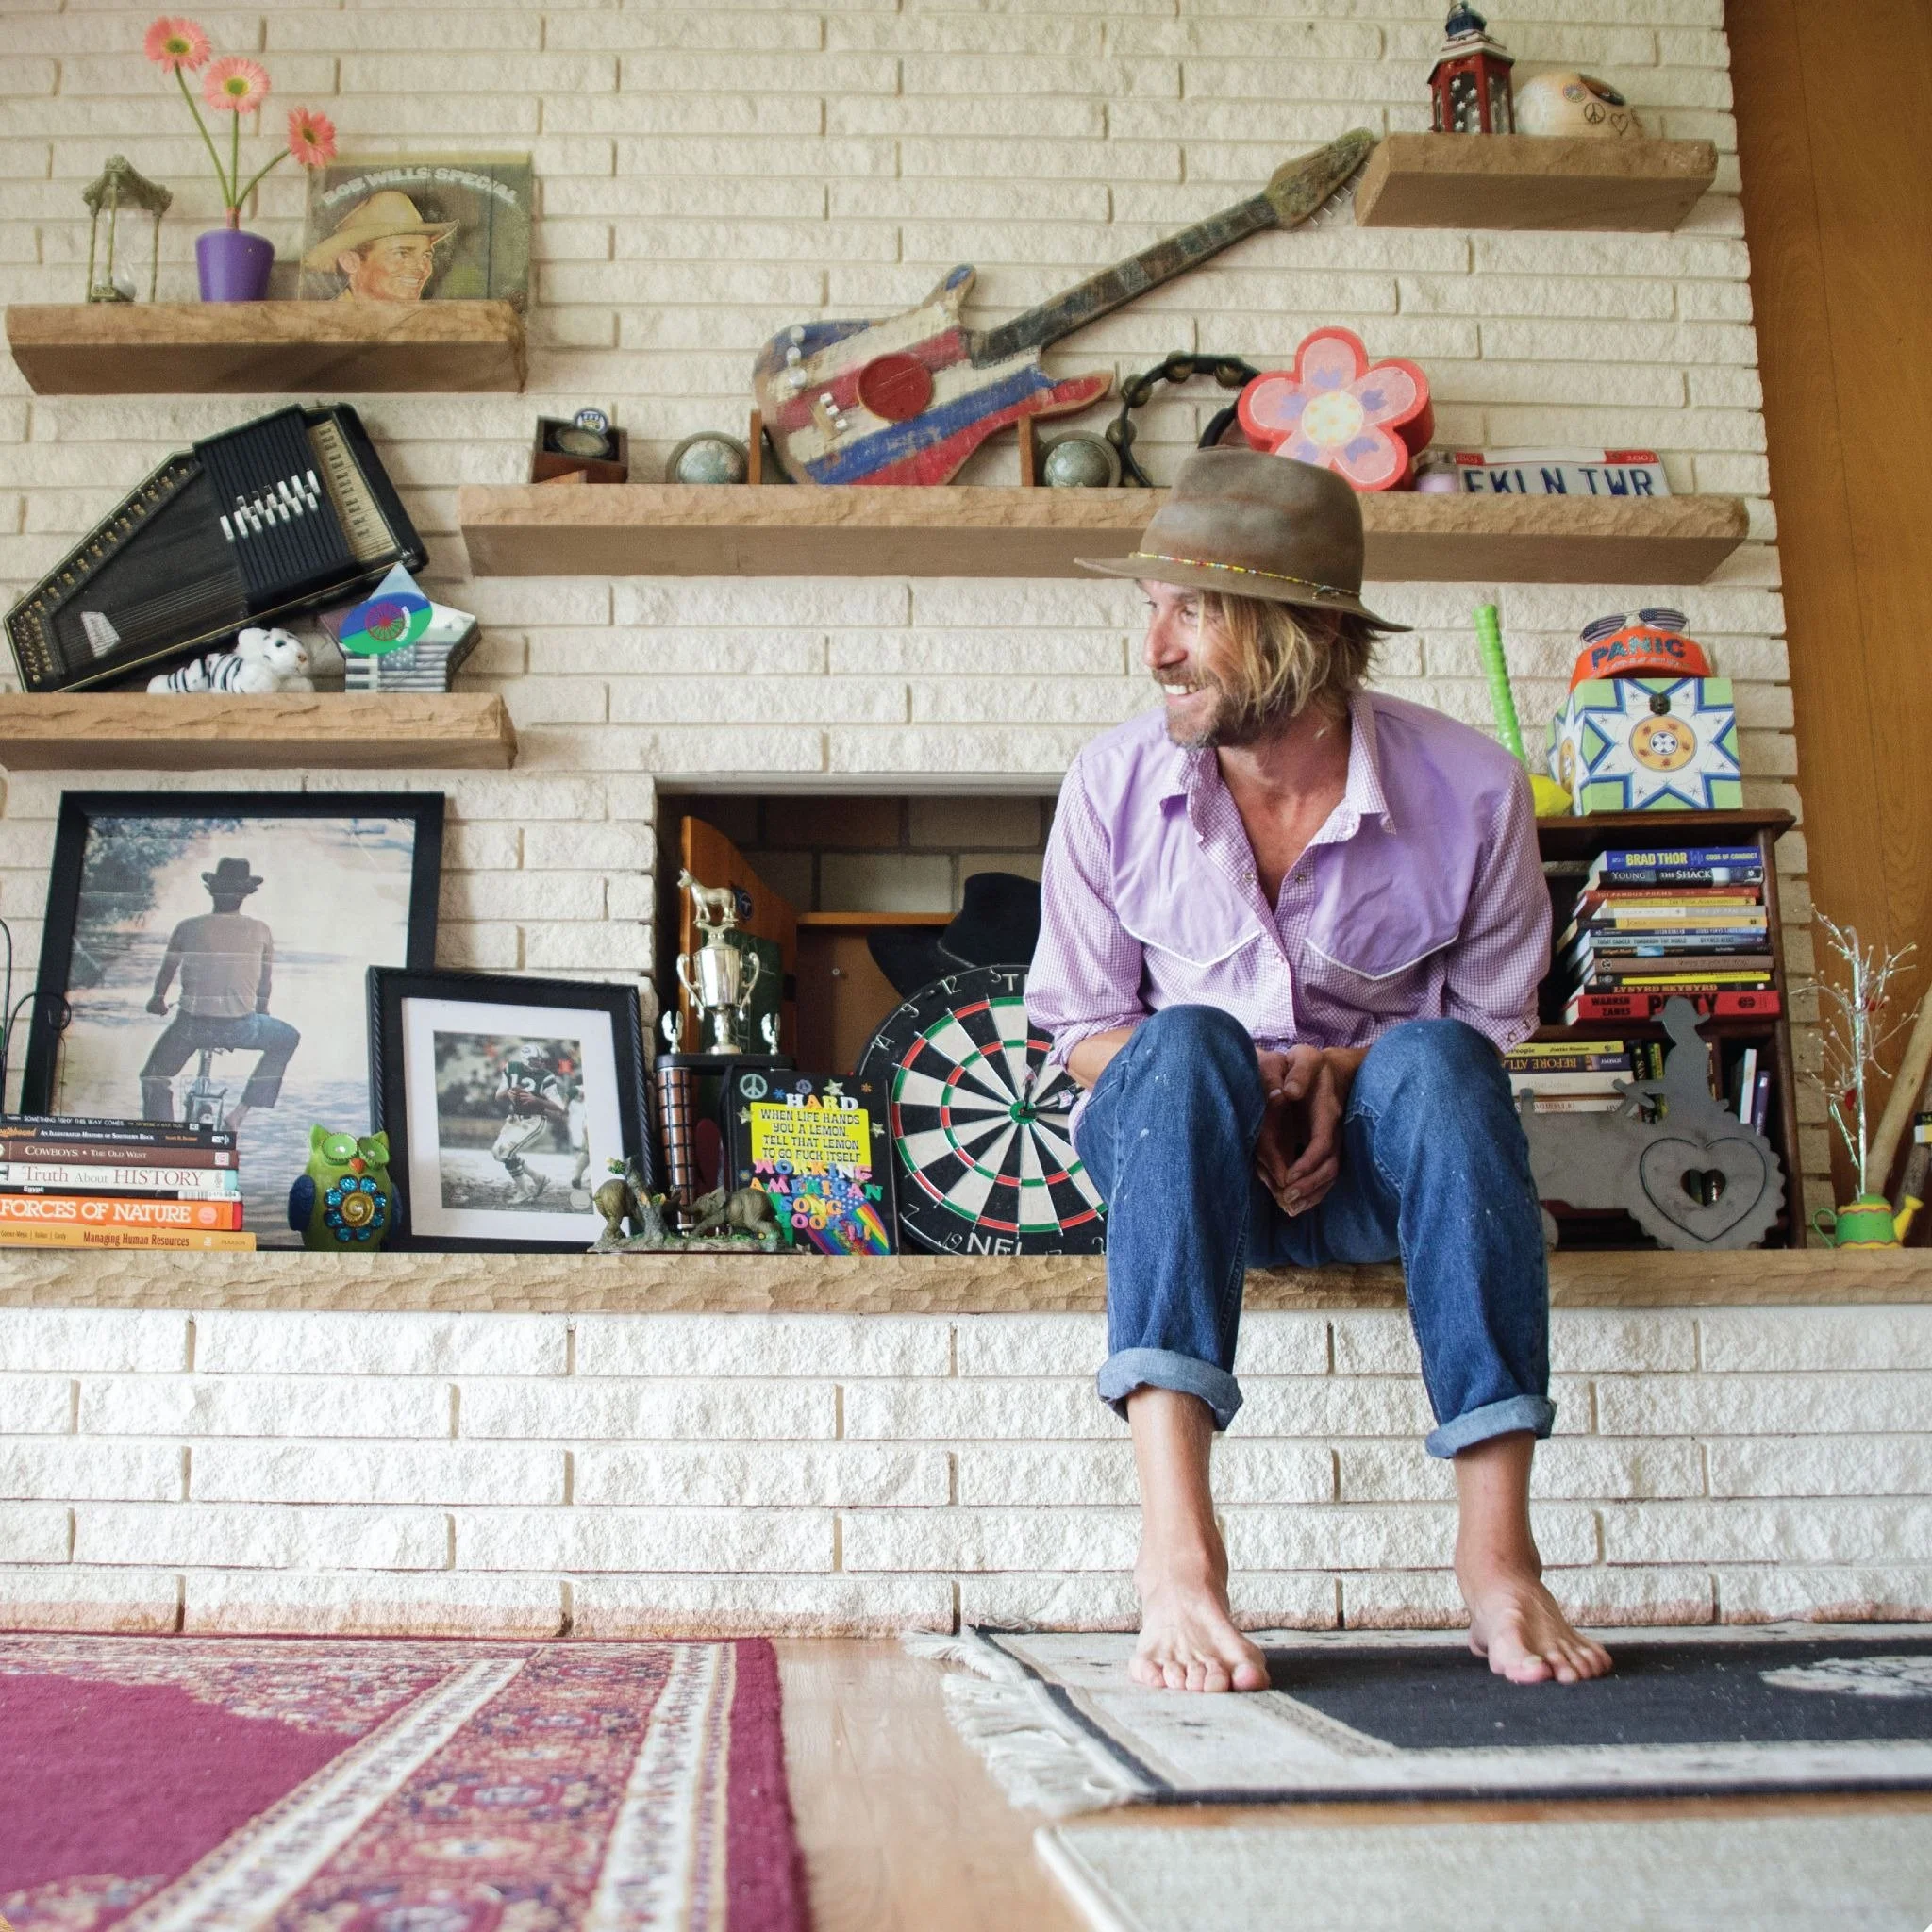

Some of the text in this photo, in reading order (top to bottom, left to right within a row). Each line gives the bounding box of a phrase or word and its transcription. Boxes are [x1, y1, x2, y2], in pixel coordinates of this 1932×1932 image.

[322, 167, 518, 205] BOB WILLS SPECIAL
[1591, 636, 1686, 670] PANIC
[1625, 853, 1656, 866] BRAD
[1657, 852, 1688, 865] THOR
[1731, 852, 1758, 860] CONDUCT
[1612, 872, 1646, 880] YOUNG
[1676, 870, 1712, 879] SHACK
[1532, 1058, 1576, 1070] BEFORE
[786, 1093, 858, 1111] HARD
[24, 1115, 57, 1124] SOMETHING
[761, 1109, 860, 1125] WHEN LIFE HANDS
[773, 1123, 794, 1134] YOU
[798, 1124, 806, 1135] A
[763, 1135, 859, 1150] TELL THAT LEMON
[25, 1145, 78, 1157] COWBOYS
[762, 1148, 861, 1163] TO GO FUCK ITSELF
[754, 1159, 872, 1179] WORKING
[23, 1167, 68, 1182] Truth
[75, 1172, 108, 1184] About
[114, 1169, 204, 1187] HISTORY
[24, 1185, 44, 1193] Egypt
[750, 1177, 883, 1201] AMERICAN
[0, 1199, 76, 1218] FORCES
[81, 1202, 109, 1220] OF
[113, 1203, 192, 1224] NATURE
[780, 1196, 844, 1216] SONG
[83, 1231, 190, 1246] Managing Human Resources
